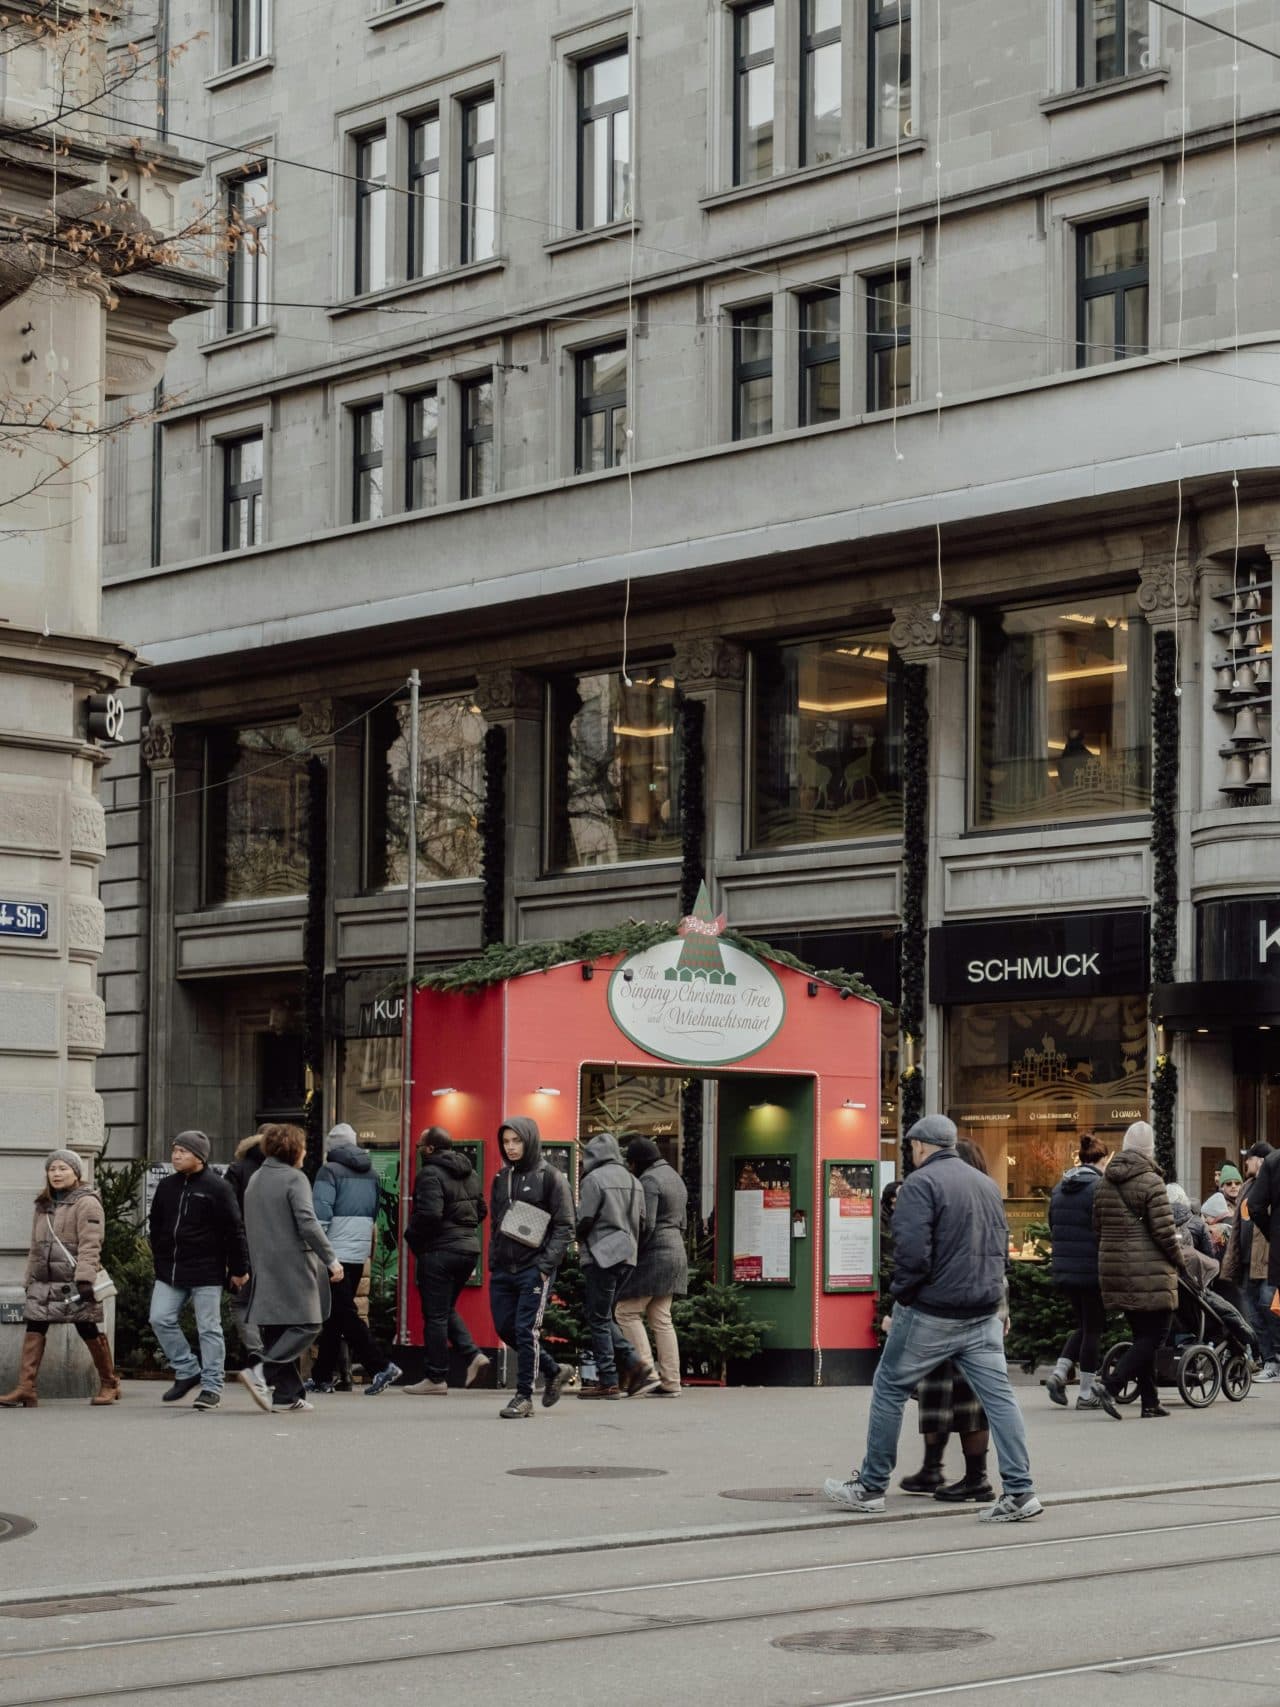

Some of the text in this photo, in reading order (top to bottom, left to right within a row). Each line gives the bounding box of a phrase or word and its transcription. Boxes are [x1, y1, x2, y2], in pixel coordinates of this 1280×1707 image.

[106, 694, 124, 743] 82
[638, 965, 660, 981] The
[967, 953, 1101, 983] SCHMUCK
[620, 980, 771, 1010] Singing Christmas Tree
